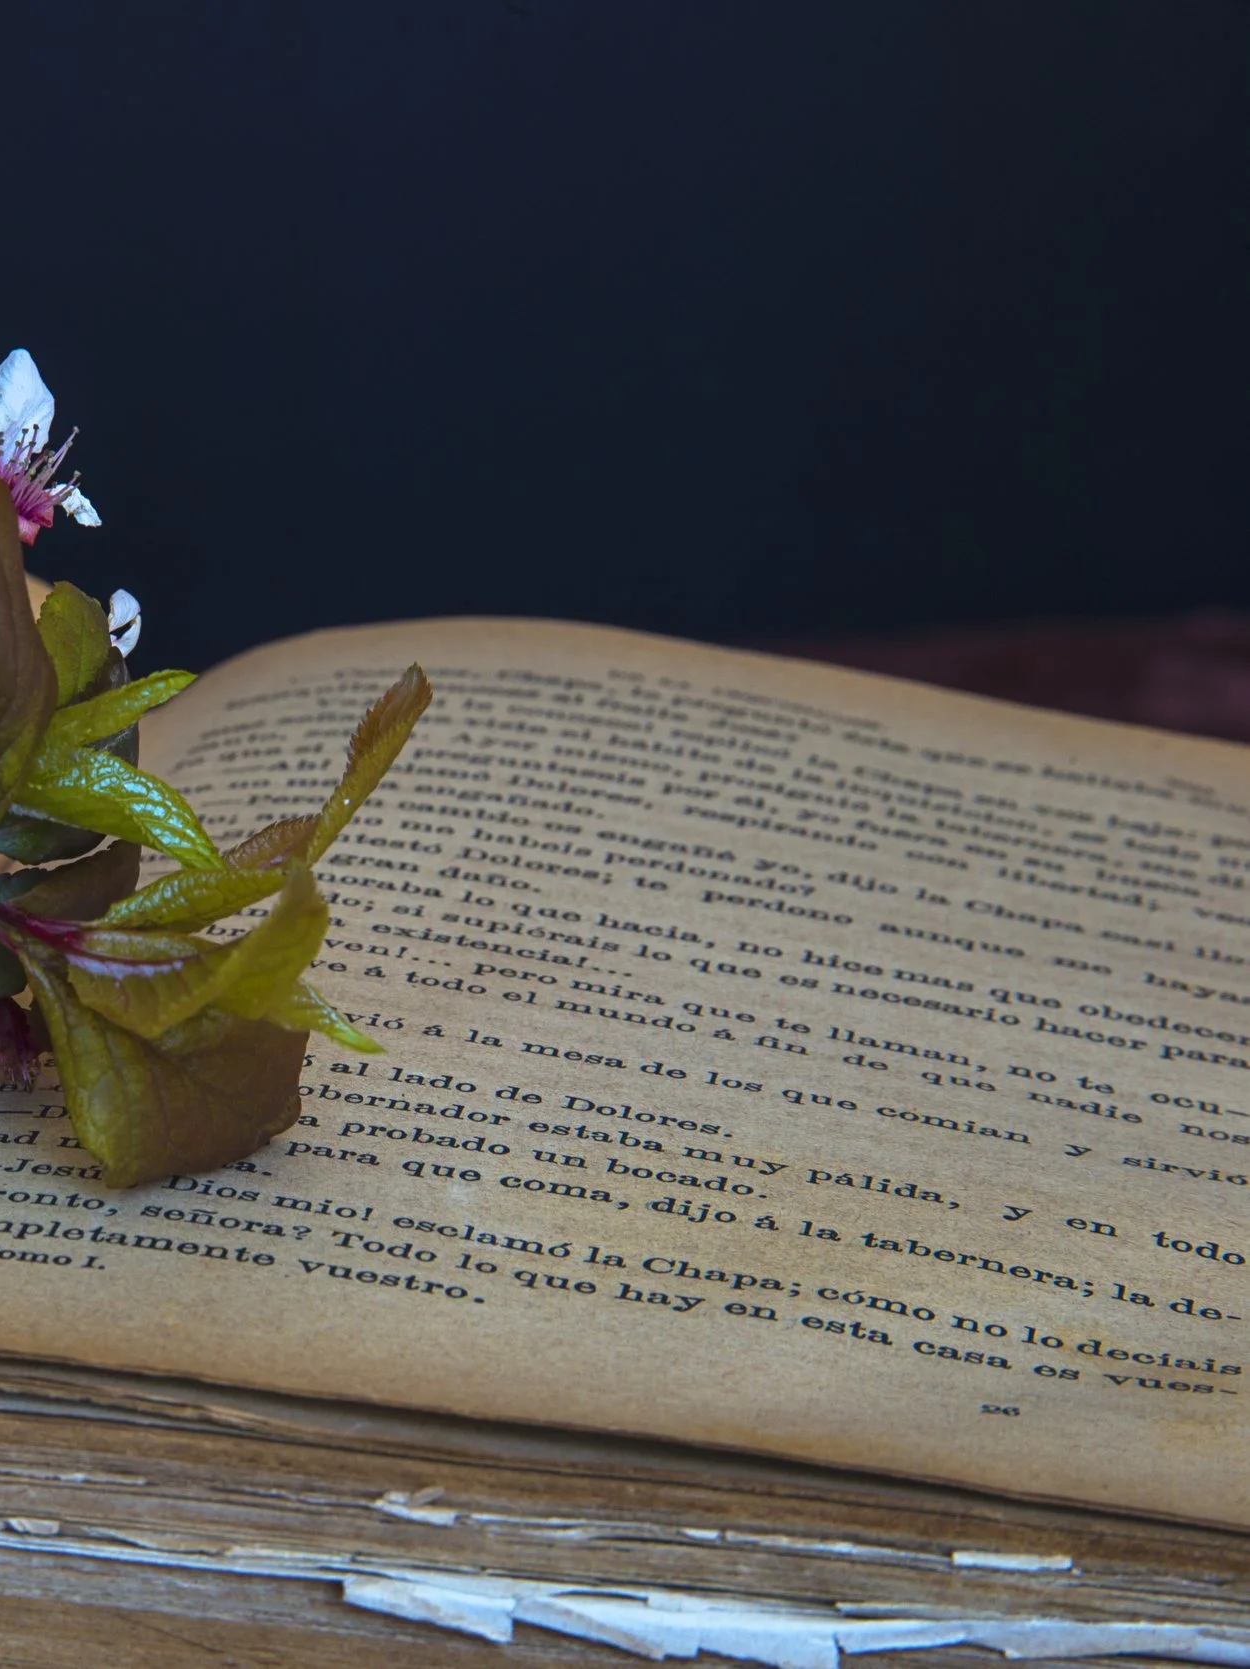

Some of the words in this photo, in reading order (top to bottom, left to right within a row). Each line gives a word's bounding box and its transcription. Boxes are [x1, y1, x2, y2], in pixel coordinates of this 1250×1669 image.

[317, 873, 444, 898] noraba
[460, 890, 495, 907] lo
[511, 904, 581, 922] que
[736, 942, 783, 957] no
[801, 950, 884, 976] hice
[893, 970, 974, 992] mas
[989, 989, 1062, 1009] que
[1078, 1005, 1250, 1046] obedecer
[327, 854, 419, 873] gran
[438, 867, 541, 893] daño.
[635, 877, 668, 891] te
[702, 890, 853, 924] perdono
[879, 923, 1025, 958] aunque
[1053, 957, 1112, 975] me
[310, 960, 347, 972] ve
[363, 966, 386, 978] á
[406, 971, 487, 994] todo
[502, 991, 537, 1005] el
[554, 1000, 696, 1032] mundo
[712, 1029, 736, 1041] á
[753, 1036, 810, 1056] fin
[842, 1054, 888, 1071] de
[921, 1072, 997, 1092] que
[1027, 1092, 1142, 1124] nadie
[1180, 1124, 1250, 1145] nos
[324, 939, 451, 967] ven!...
[472, 963, 558, 985] pero
[570, 980, 665, 1005] mira
[682, 1003, 755, 1023] que
[775, 1018, 811, 1034] te
[826, 1027, 987, 1072] llaman,
[1007, 1065, 1057, 1082] no
[1077, 1076, 1115, 1094] te
[327, 892, 374, 912] do;
[392, 905, 424, 917] si
[634, 944, 672, 961] lo
[689, 959, 762, 979] que
[779, 975, 819, 989] es
[831, 983, 1020, 1026] necesario
[1034, 1017, 1148, 1050] hacer
[1159, 1045, 1250, 1070] para
[297, 1084, 512, 1125] obernador
[527, 1122, 667, 1155] estaba
[681, 1147, 790, 1175] muy
[806, 1169, 960, 1209] pálida,
[1003, 1205, 1033, 1221] y
[1066, 1218, 1118, 1238] en
[1151, 1231, 1246, 1265] todo
[329, 1062, 369, 1077] al
[387, 1067, 477, 1093] lado
[495, 1086, 542, 1104] de
[563, 1096, 733, 1138] Dolores.
[337, 1122, 510, 1155] probado
[532, 1150, 588, 1173] un
[606, 1158, 767, 1199] bocado.
[342, 1013, 405, 1030] vió
[421, 1025, 445, 1037] á
[464, 1029, 503, 1047] la
[520, 1042, 627, 1069] mesa
[640, 1061, 687, 1079] de
[705, 1071, 763, 1092] los
[782, 1090, 858, 1111] que
[1064, 1144, 1093, 1157] y
[1122, 1157, 1248, 1185] sirvió
[81, 1256, 105, 1270] I.
[140, 1205, 312, 1240] señora?
[331, 1229, 437, 1262] Todo
[455, 1253, 498, 1274] lo
[512, 1270, 597, 1294] que
[613, 1283, 706, 1312] hay
[724, 1303, 778, 1322] en
[801, 1316, 893, 1346] esta
[913, 1341, 1012, 1370] casa
[1034, 1365, 1080, 1380] es
[1102, 1374, 1238, 1395] vues-
[161, 1174, 260, 1202] Dios
[271, 1196, 374, 1222] mio!
[393, 1217, 573, 1258] esclamó
[583, 1246, 627, 1270] la
[642, 1257, 801, 1297] Chapa;
[816, 1288, 936, 1321] cómo
[950, 1315, 1008, 1337] no
[1021, 1326, 1064, 1349] lo
[285, 1141, 380, 1167] para
[402, 1161, 482, 1182] que
[499, 1176, 630, 1210] coma,
[649, 1197, 737, 1223] dijo
[754, 1215, 779, 1232] á
[798, 1221, 841, 1242] la
[860, 1232, 1094, 1297] tabernera;
[1111, 1283, 1155, 1307] la
[1168, 1298, 1241, 1320] de-
[298, 1259, 485, 1304] vuestro.
